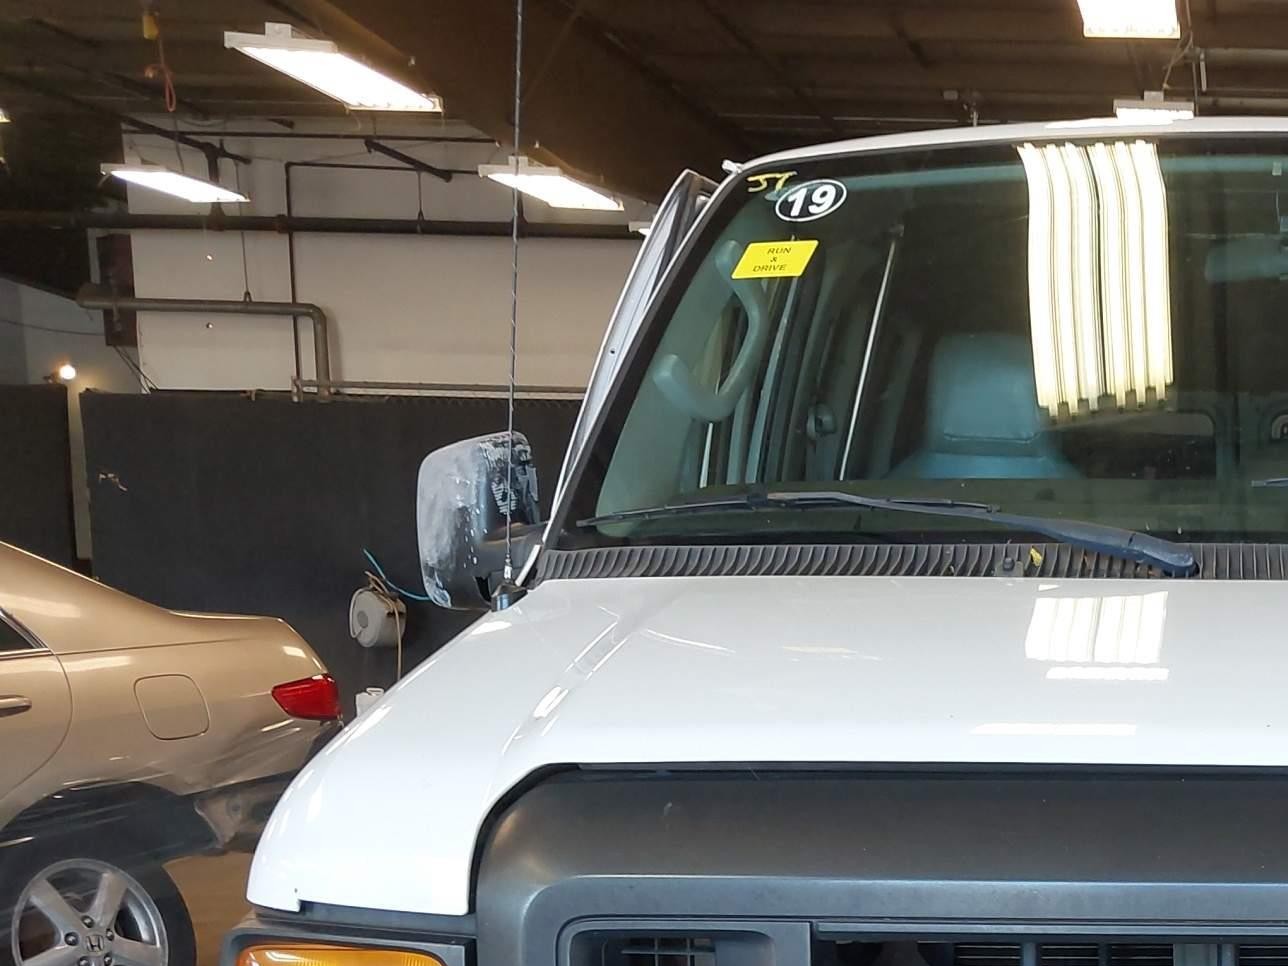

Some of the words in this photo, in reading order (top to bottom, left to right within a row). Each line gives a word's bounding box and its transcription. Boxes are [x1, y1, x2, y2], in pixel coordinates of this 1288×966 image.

[788, 184, 836, 217] 19
[766, 247, 792, 255] RUN
[752, 263, 787, 273] DRIVE
